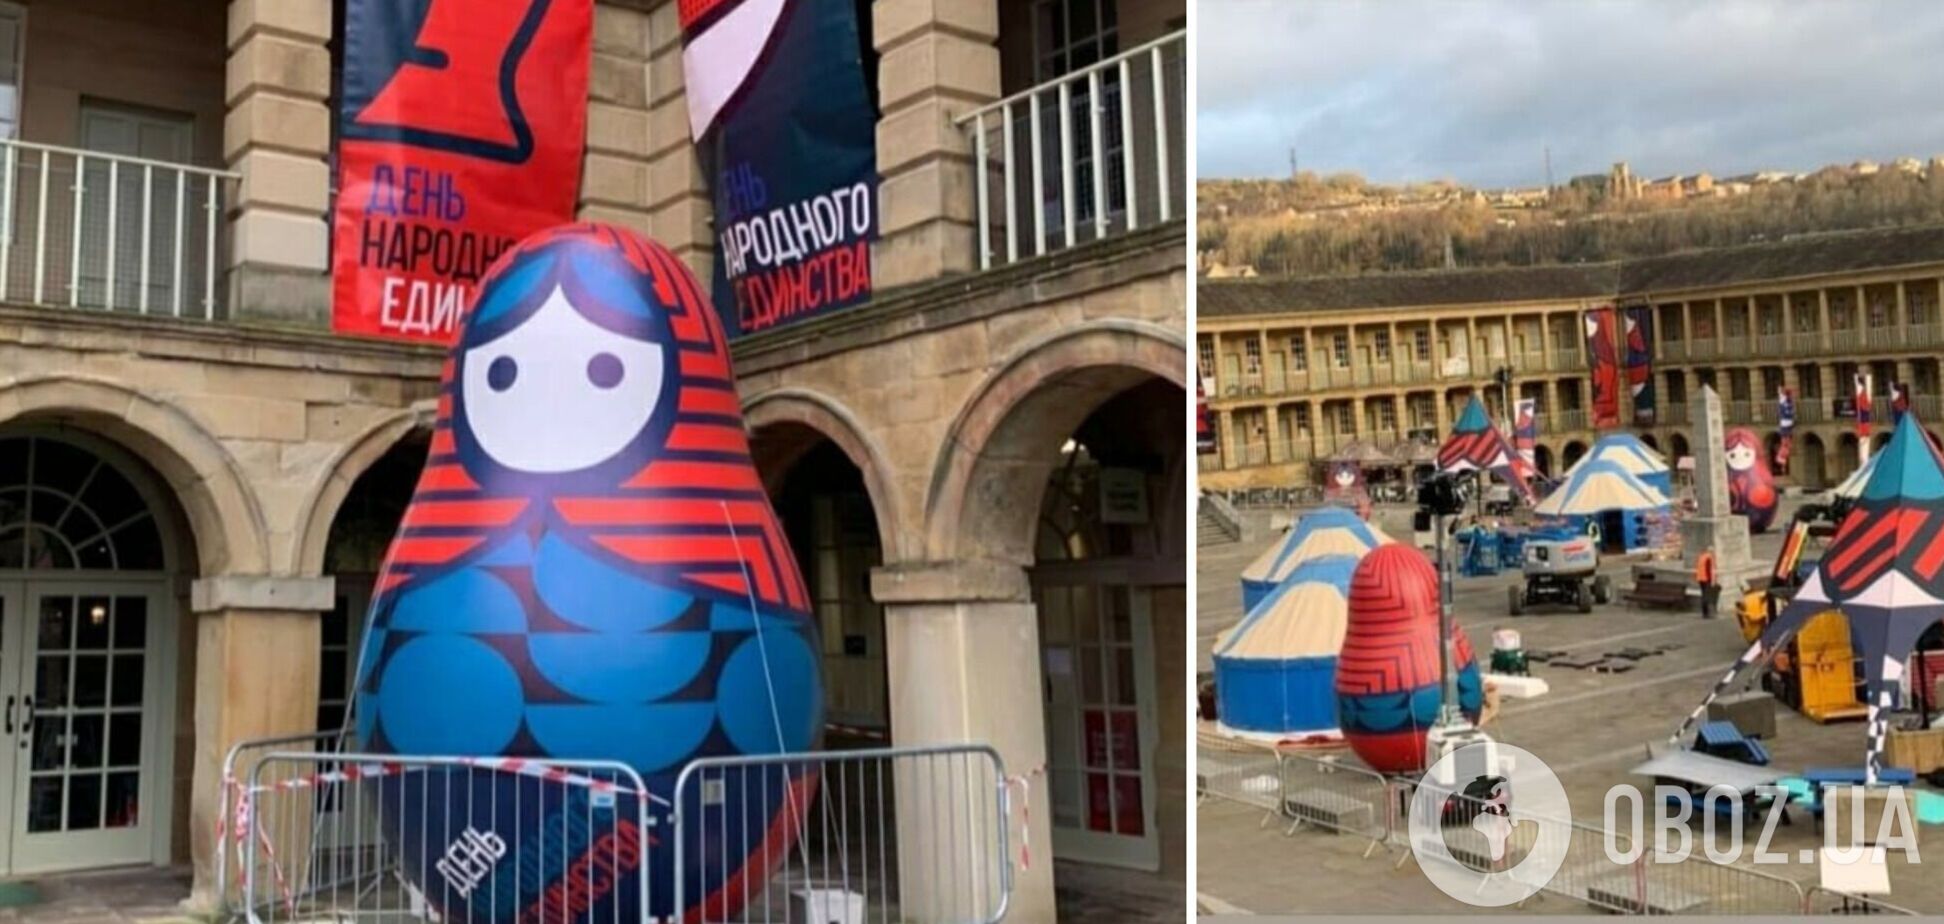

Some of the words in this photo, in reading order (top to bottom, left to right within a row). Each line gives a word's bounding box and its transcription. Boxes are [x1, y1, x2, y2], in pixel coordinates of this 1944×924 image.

[366, 164, 466, 222] ДЕНЬ
[360, 219, 516, 284] НАРОДН
[735, 240, 870, 330] ЕДИНСТВА
[436, 824, 507, 899] ДЕНЬ
